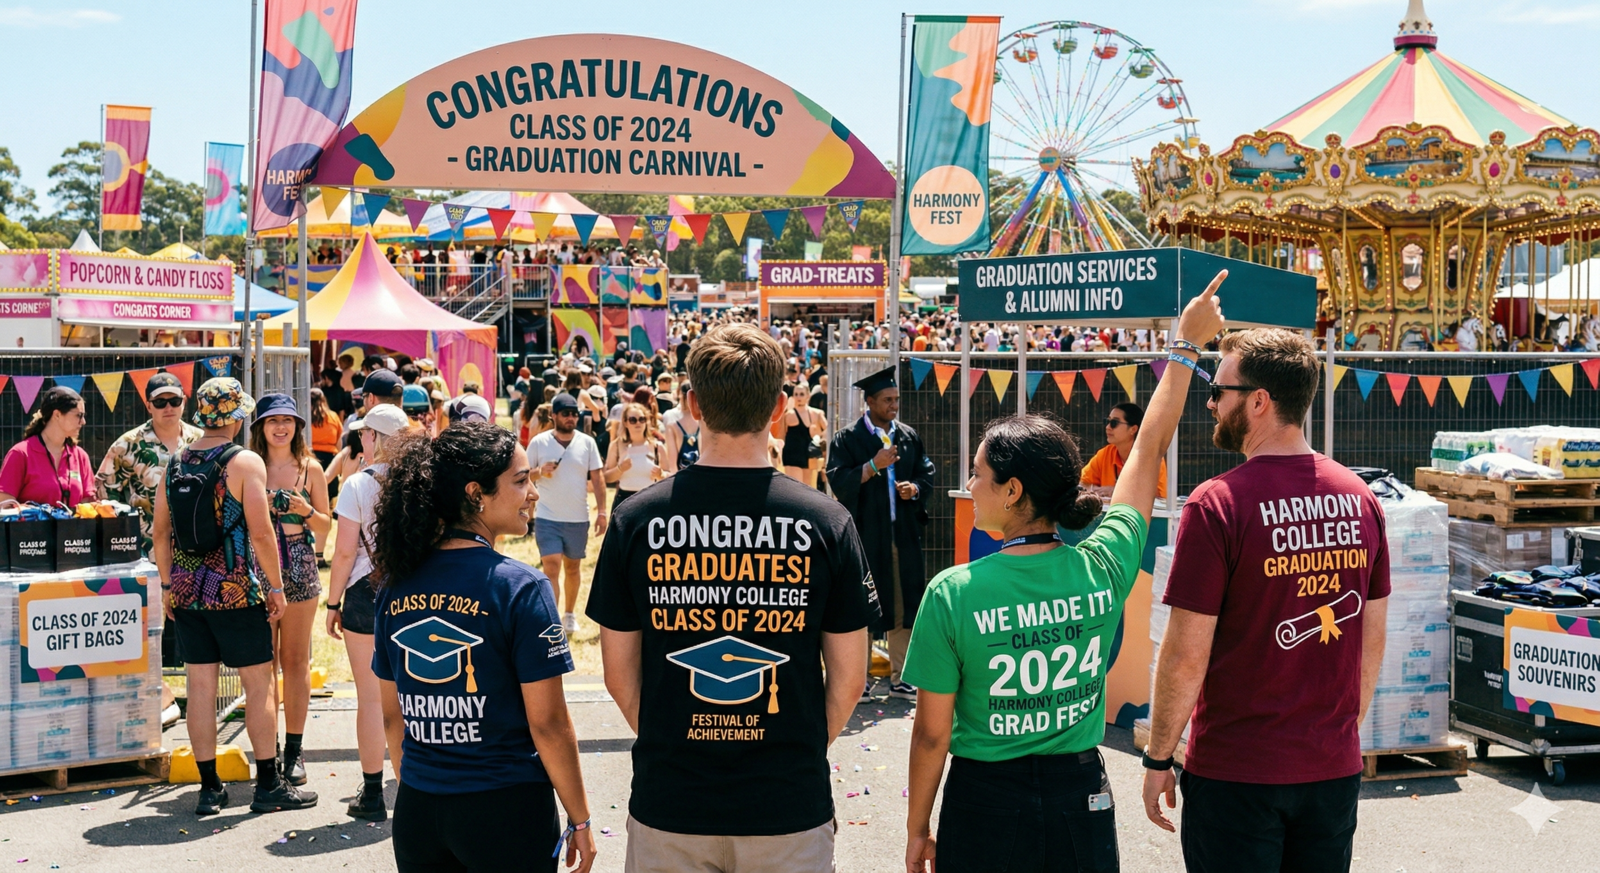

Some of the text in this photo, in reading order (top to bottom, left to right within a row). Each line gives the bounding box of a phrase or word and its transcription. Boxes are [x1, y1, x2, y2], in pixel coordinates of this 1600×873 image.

[426, 59, 783, 138] CONGRATULATIONS
[509, 113, 692, 143] CLASS OF 2024
[465, 145, 621, 174] GRADUATION
[628, 149, 746, 177] CARNIVAL
[266, 168, 313, 185] HARM
[282, 185, 302, 201] FE
[913, 193, 981, 208] HARMONY
[930, 210, 963, 225] FEST
[70, 261, 225, 290] POPCORN & CANDY FLOSS
[770, 266, 875, 284] GRAD-TREATS
[976, 256, 1157, 288] GRADUATION SERVICES
[113, 302, 192, 319] CONGRATS CORNER
[1004, 286, 1123, 314] & ALUMNI INFO
[1259, 493, 1363, 527] HARMONY
[647, 514, 813, 551] CONGRATS
[1272, 520, 1362, 553] COLLEGE
[647, 552, 811, 584] GRADUATES!
[1263, 548, 1368, 578] GRADUATION
[648, 586, 809, 607] HARMONY COLLEGE
[1297, 572, 1341, 598] 2024
[390, 593, 480, 617] CLASS OF 2024
[973, 588, 1113, 635] WE MADE IT!
[32, 608, 138, 632] CLASS OF 2024
[651, 608, 806, 633] CLASS OF 2024
[46, 628, 125, 651] GIFT BAGS
[1011, 624, 1084, 650] CLASS OF
[988, 634, 1102, 697] 2024
[1514, 642, 1600, 672] GRADUATION
[1518, 664, 1596, 693] SOUVENIRS
[397, 691, 487, 719] HARMONY
[988, 677, 1101, 711] HARMONY COLLEGE
[692, 713, 760, 727] FESTIVAL OF
[989, 692, 1099, 736] GRAD FEST
[404, 718, 482, 744] OLLEGE
[687, 728, 765, 741] ACHIEVEMENT
